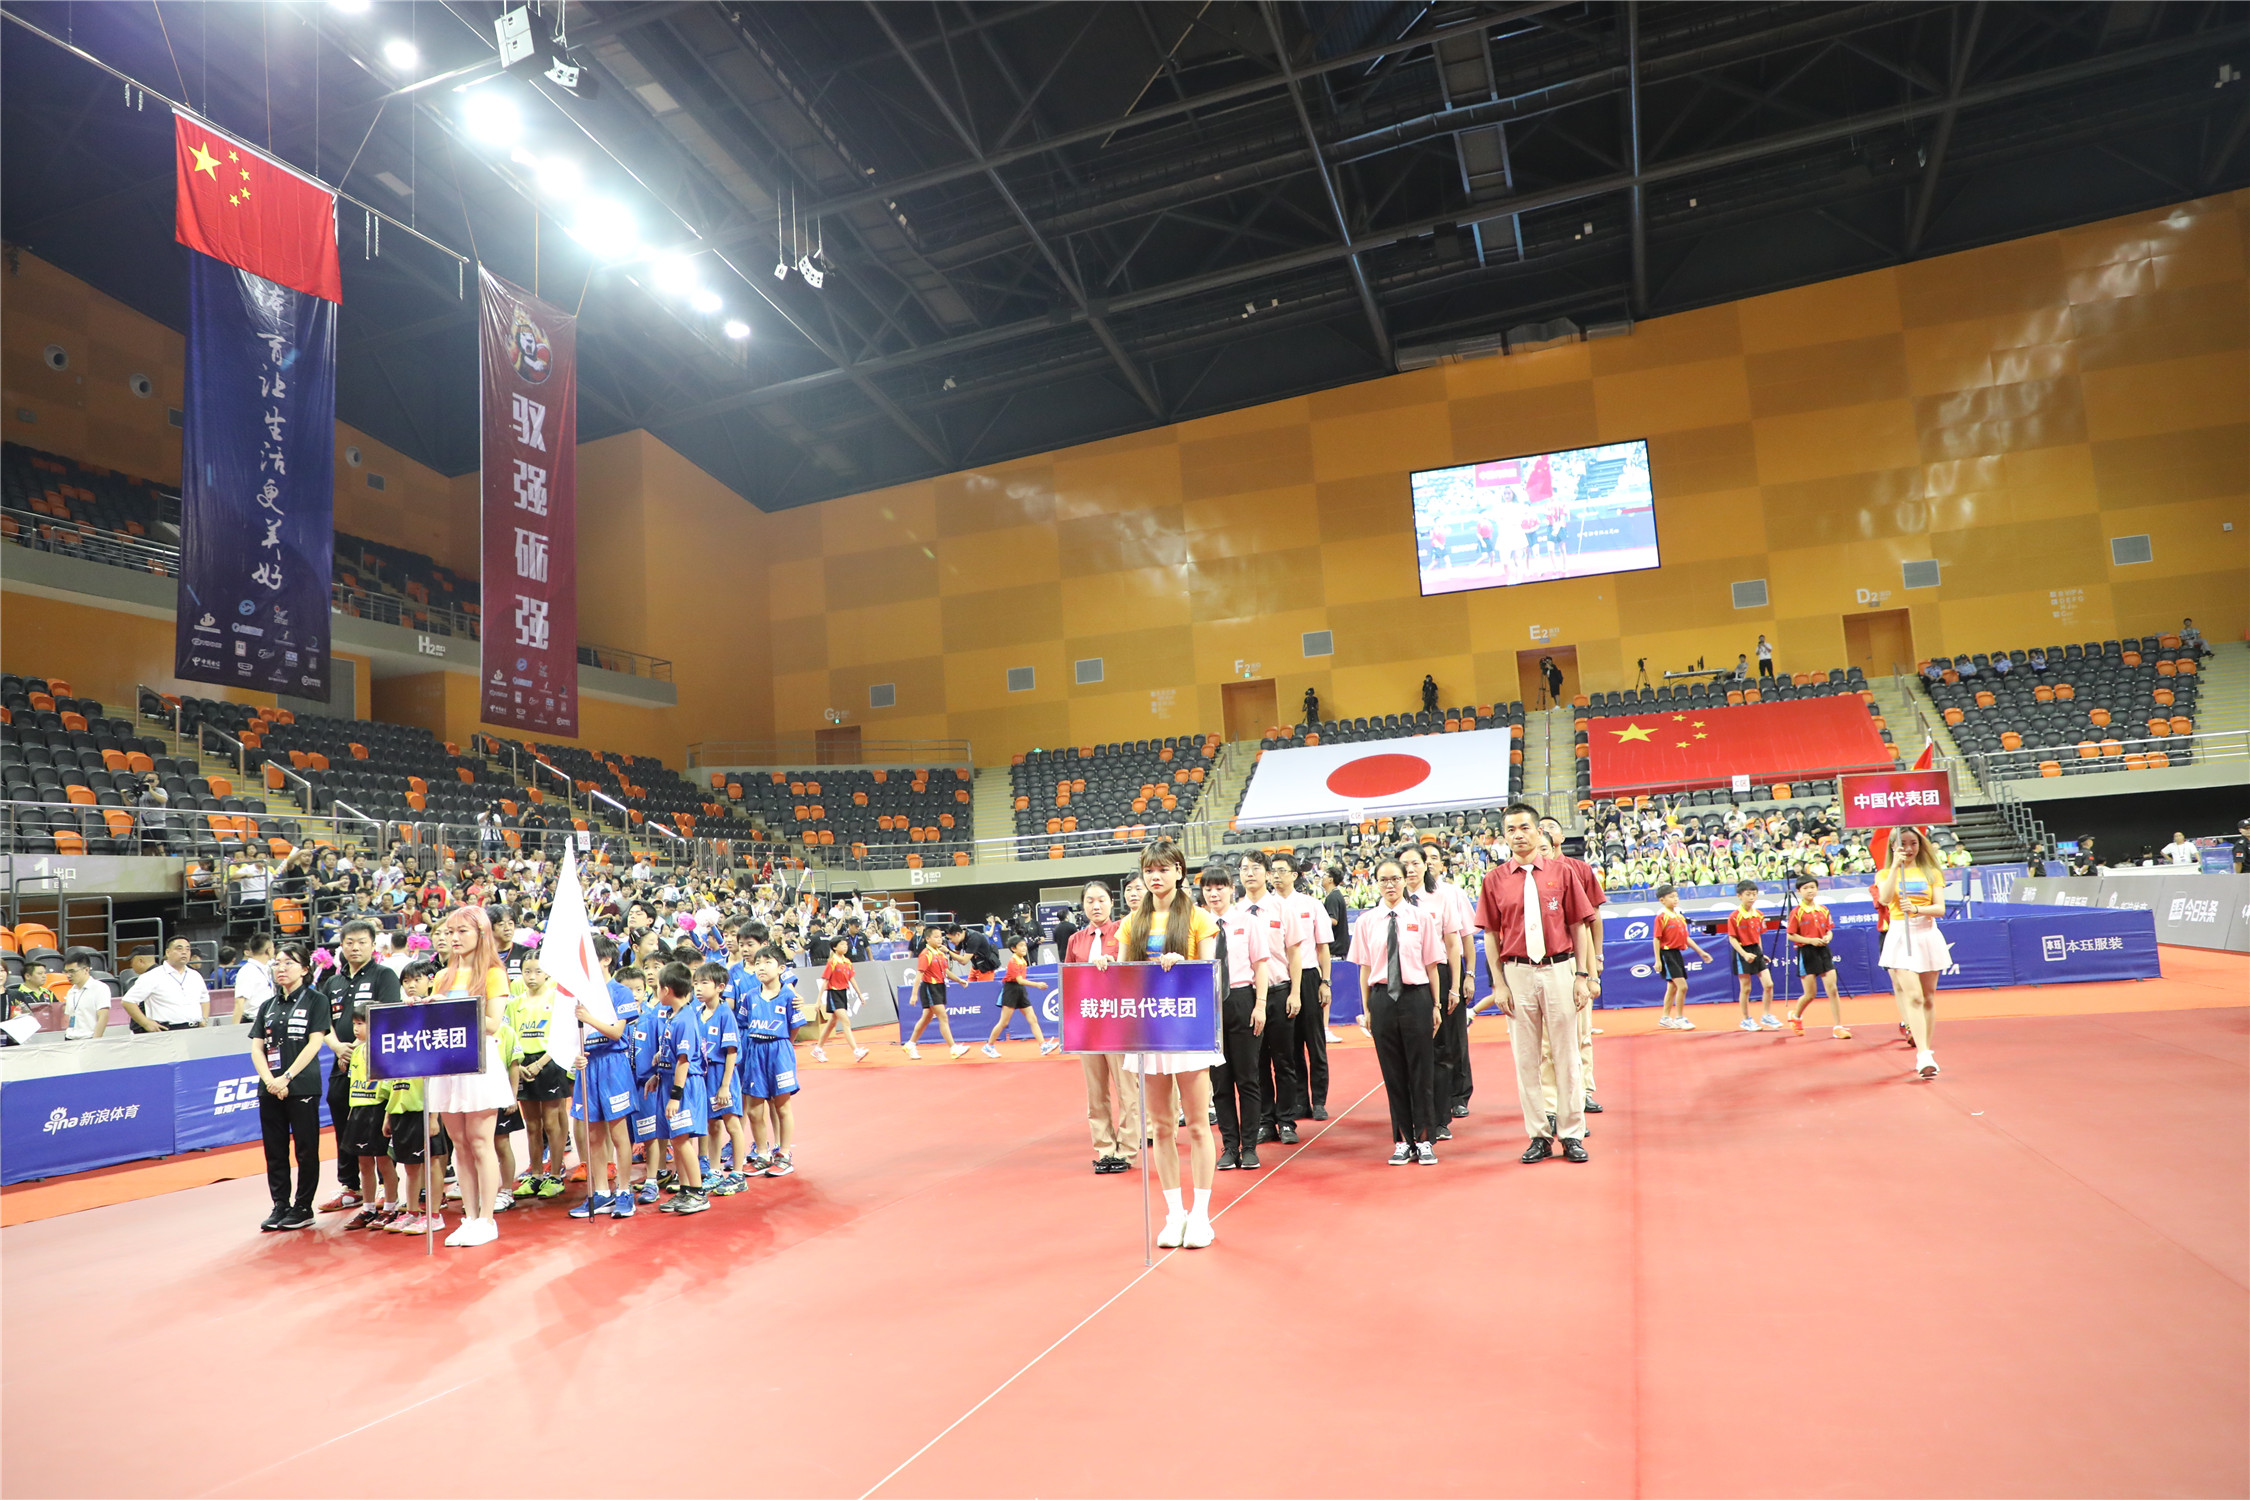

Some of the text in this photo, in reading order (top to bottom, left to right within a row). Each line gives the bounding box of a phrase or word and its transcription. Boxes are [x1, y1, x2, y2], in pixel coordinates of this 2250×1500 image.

[512, 392, 549, 650] 驭强砺强
[1853, 789, 1940, 809] 中国代表团
[33, 857, 49, 889] 1
[911, 869, 929, 886] B1
[53, 881, 69, 889] Eit
[2066, 936, 2124, 953] 本珏服装
[1080, 996, 1197, 1018] 裁判员代表团
[381, 1026, 467, 1054] 日本代表团
[42, 1104, 141, 1135] sina 新浪体育
